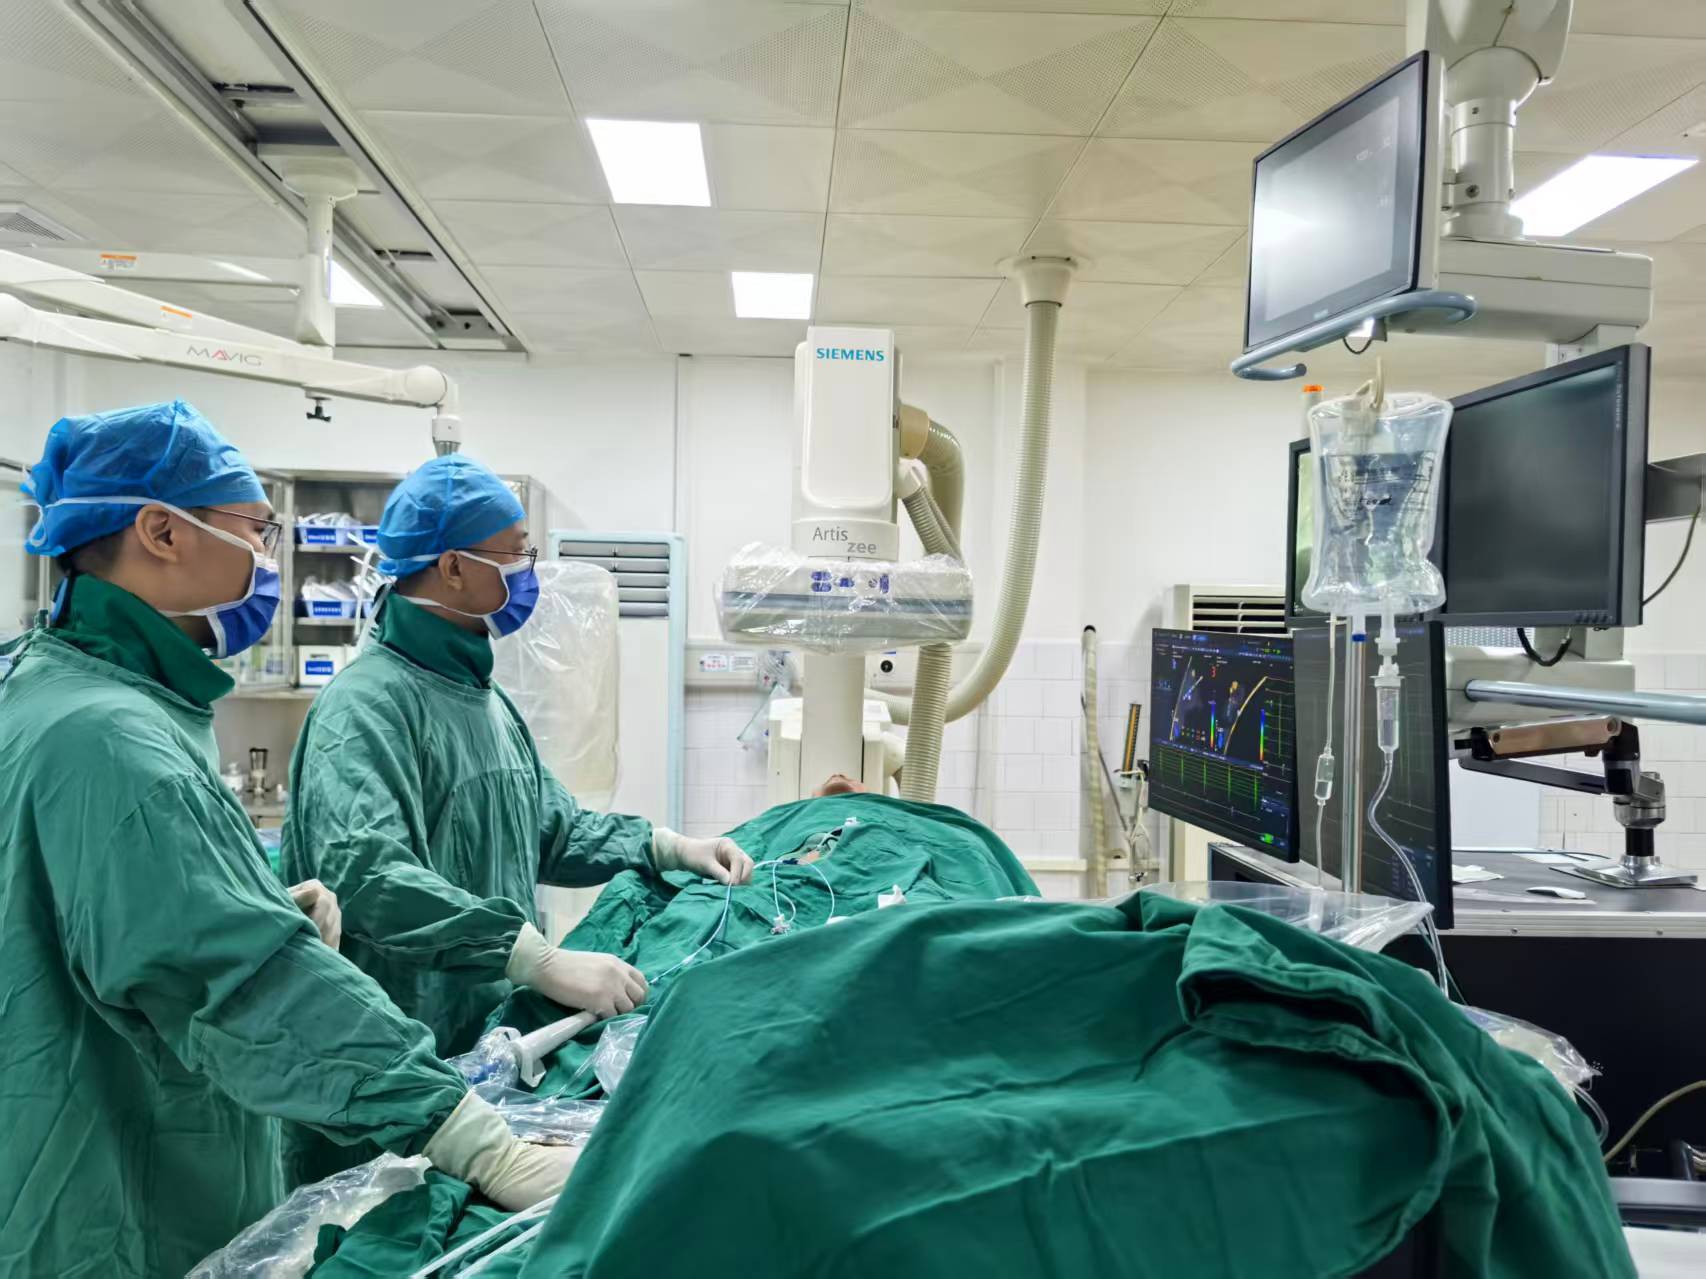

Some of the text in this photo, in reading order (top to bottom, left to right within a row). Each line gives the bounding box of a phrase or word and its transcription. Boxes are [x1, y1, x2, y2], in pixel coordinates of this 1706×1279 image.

[186, 345, 262, 366] MAVIG
[816, 348, 885, 362] SIEMENS
[812, 526, 848, 542] Artis
[847, 542, 877, 554] zee
